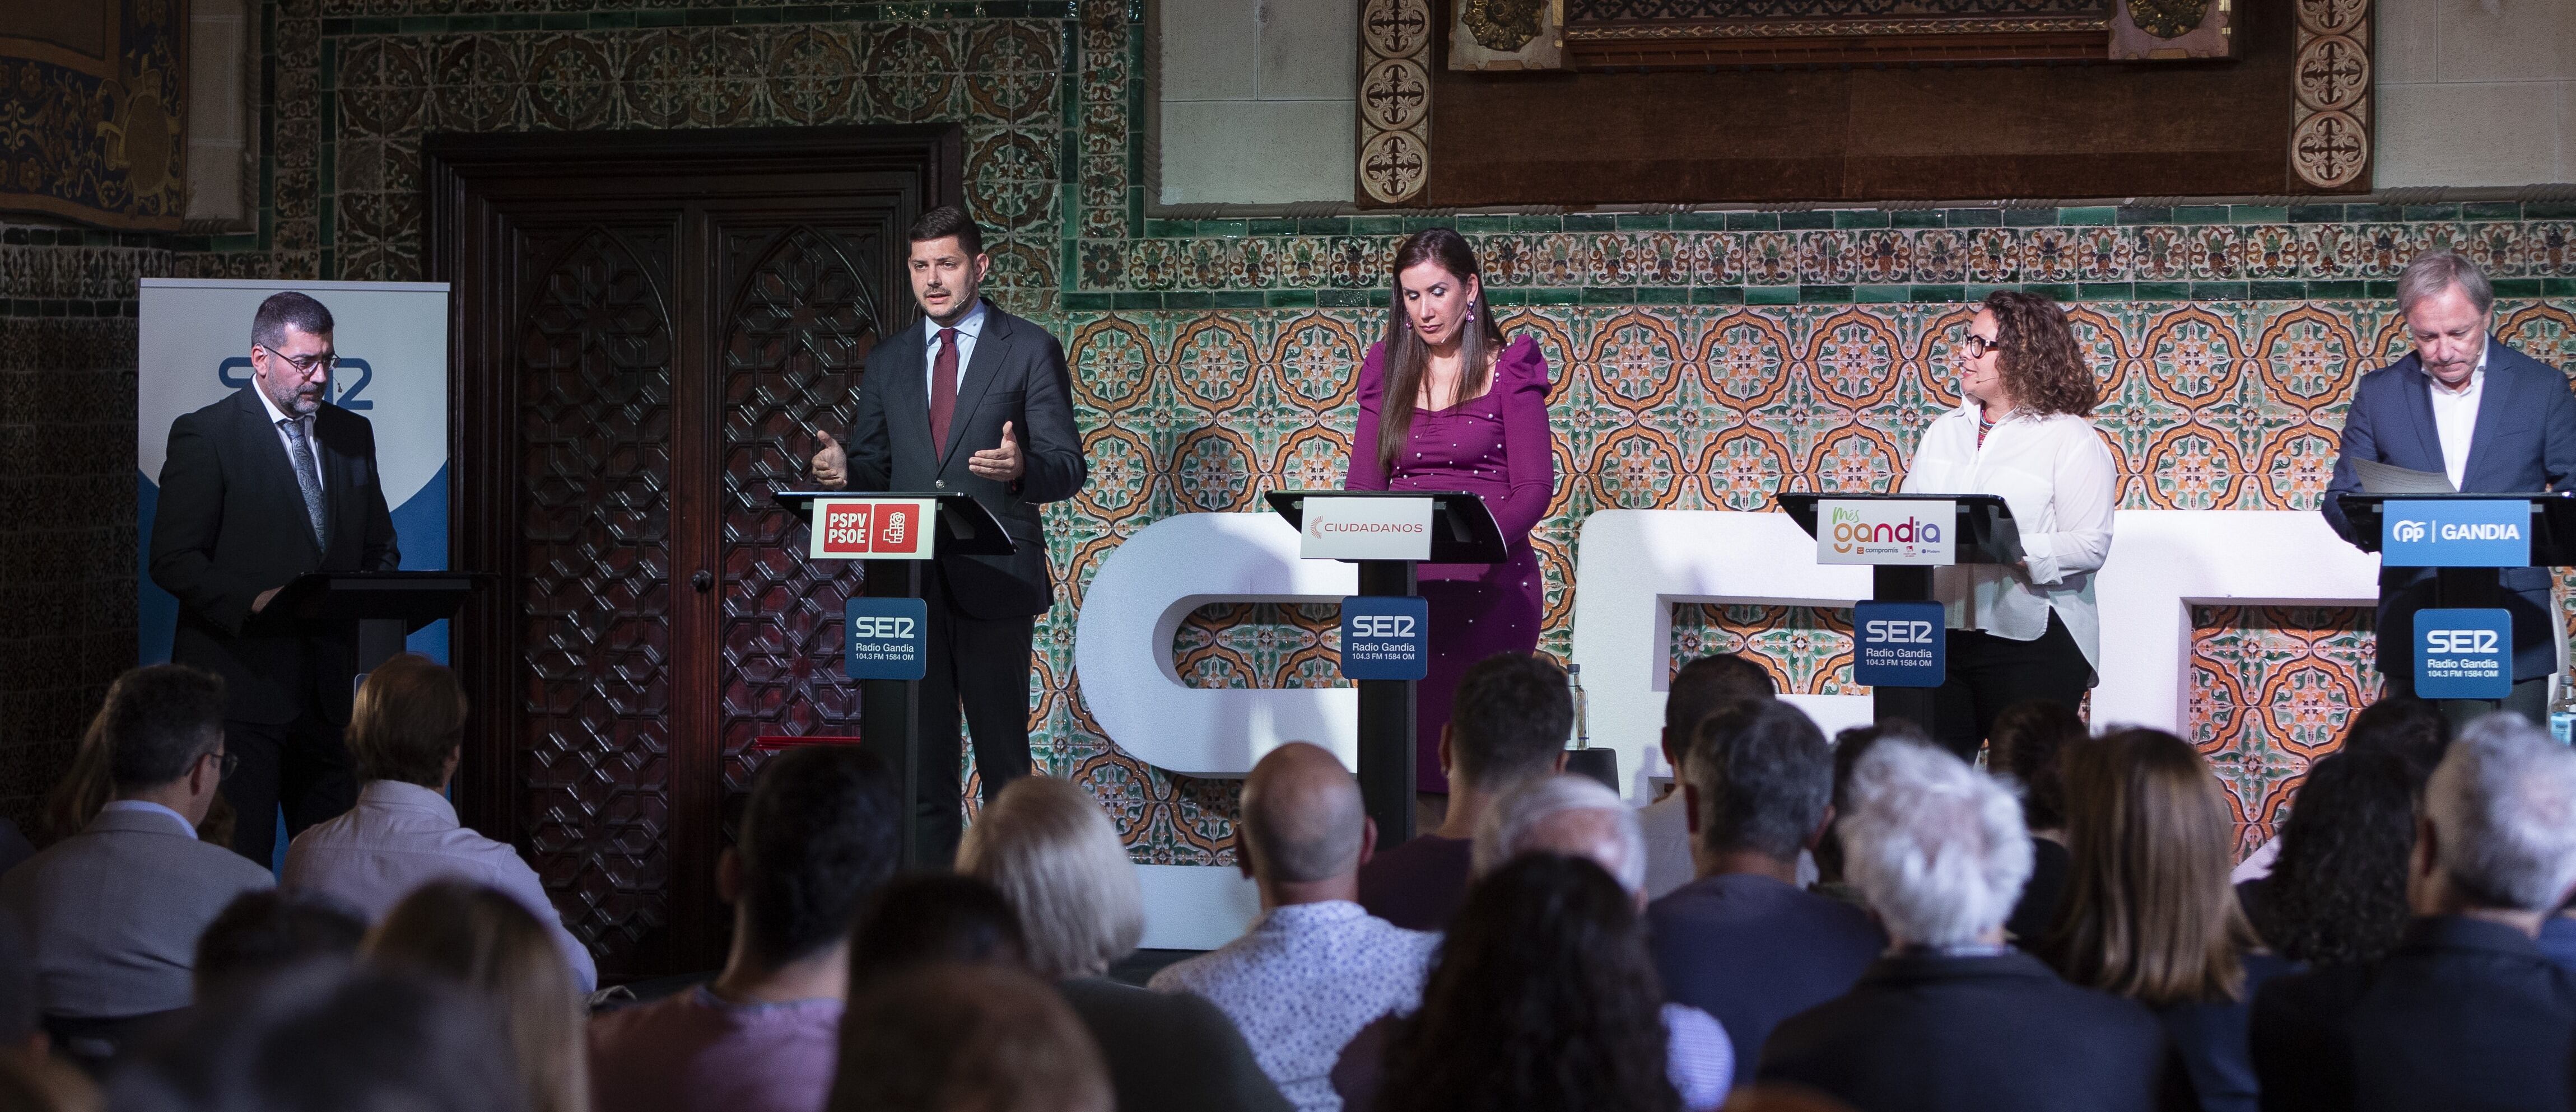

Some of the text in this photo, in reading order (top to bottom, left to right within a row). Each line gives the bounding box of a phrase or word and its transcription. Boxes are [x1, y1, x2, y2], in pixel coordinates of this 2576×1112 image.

[830, 513, 867, 528] PSPV
[1324, 523, 1423, 533] CIUDADANOS
[828, 529, 866, 544] PSOE
[2442, 524, 2520, 540] GANDIA
[856, 616, 915, 638] SER
[1352, 615, 1415, 637] SER
[1866, 620, 1932, 643] SER
[856, 643, 914, 652] Radio Gandia
[1353, 642, 1415, 652] Radio Gandia
[2426, 630, 2499, 653] SER
[1866, 648, 1932, 658] Radio Gandia
[2427, 658, 2499, 669] Radio Gandia
